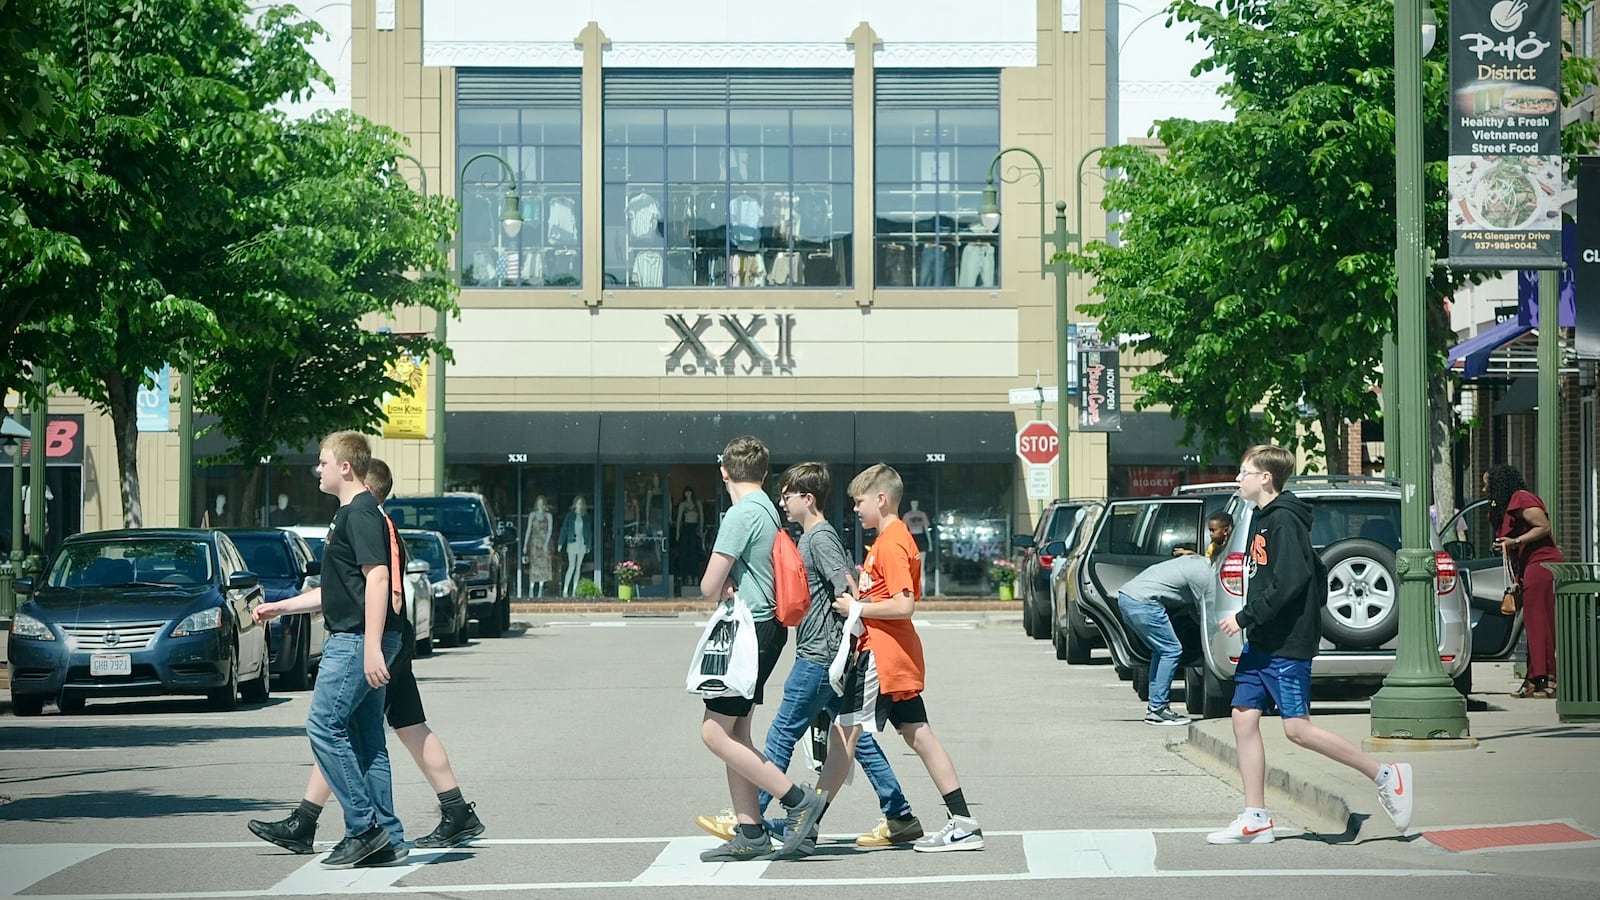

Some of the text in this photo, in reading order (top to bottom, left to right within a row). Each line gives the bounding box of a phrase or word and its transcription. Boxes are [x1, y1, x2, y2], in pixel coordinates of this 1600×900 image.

[1478, 64, 1536, 80] District
[1461, 117, 1549, 128] Healthy & Fresh
[1472, 130, 1538, 140] Vietnamese
[1472, 143, 1538, 153] Street Food
[1461, 232, 1550, 241] 4474 Glengarry Drive
[664, 314, 796, 368] XXI
[1107, 368, 1115, 410] NOW OPEN
[1021, 436, 1059, 452] STOP
[508, 454, 528, 462] XXI
[926, 454, 946, 462] XXI
[1132, 479, 1174, 487] BIGGEST
